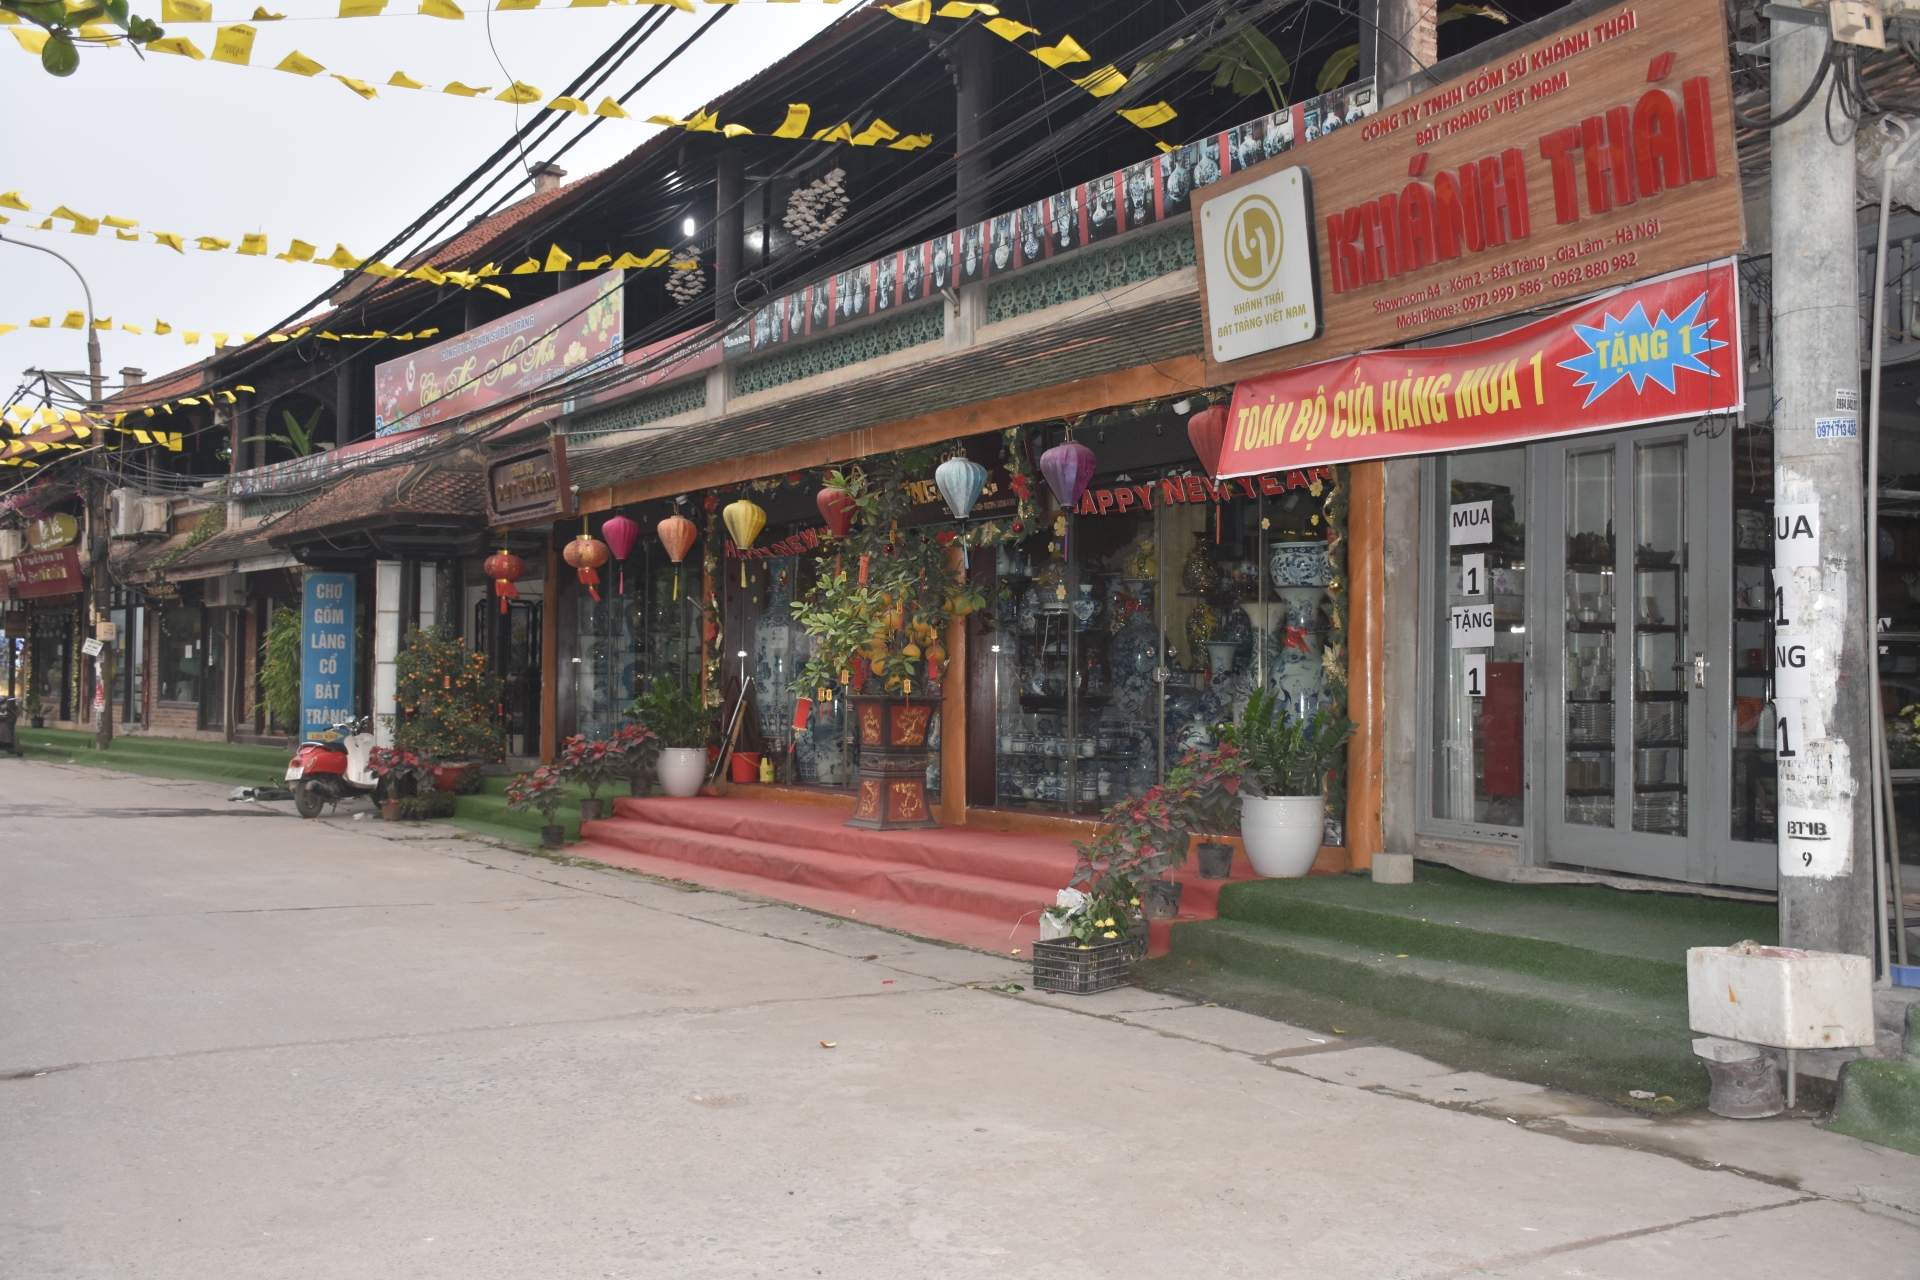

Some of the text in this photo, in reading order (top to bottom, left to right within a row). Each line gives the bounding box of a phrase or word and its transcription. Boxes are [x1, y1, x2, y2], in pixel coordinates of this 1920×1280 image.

[1361, 8, 1637, 142] CÔNG TY TNHH GỐM SỨ KHÁNH THÁI
[1416, 71, 1569, 147] BÁT TRÀNG VIỆT NAM
[1326, 50, 1717, 295] KHÁNH THÁI
[1372, 290, 1427, 314] Showroom
[1427, 283, 1442, 299] A4
[1490, 262, 1512, 280] Bát
[1513, 255, 1548, 276] Tràng
[1555, 246, 1576, 263] Gia
[1576, 237, 1605, 257] Lâm
[1615, 227, 1635, 246] Hà
[1635, 218, 1661, 240] Nội
[1462, 290, 1491, 312] 0972
[1491, 285, 1515, 304] 999
[1518, 280, 1542, 299] 586
[1551, 268, 1584, 288] 0962
[1585, 260, 1610, 280] 880
[1611, 251, 1637, 273] 982
[1234, 288, 1284, 316] KHÁNH THÁI
[1218, 303, 1306, 338] BÁT TRÀNG VIỆT NAM
[1595, 325, 1693, 374] TẶNG 1
[1233, 350, 1546, 453] TOÀN BỘ CỬA HÀNG MUA 1
[1074, 484, 1152, 515] APPY
[1453, 508, 1490, 528] MUA
[1774, 514, 1814, 541] UA
[771, 527, 819, 556] NEW
[316, 582, 344, 602] CHỢ
[1467, 567, 1480, 595] 1
[314, 603, 344, 624] GỐM
[1775, 586, 1790, 626] 1
[1453, 609, 1492, 632] TẶNG
[311, 630, 346, 649] LÀNG
[319, 653, 338, 674] CỔ
[315, 681, 341, 700] BÁT
[1468, 668, 1481, 695] 1
[305, 706, 349, 725] TRÀNG
[1777, 716, 1796, 758] 1
[1802, 851, 1812, 867] 9
